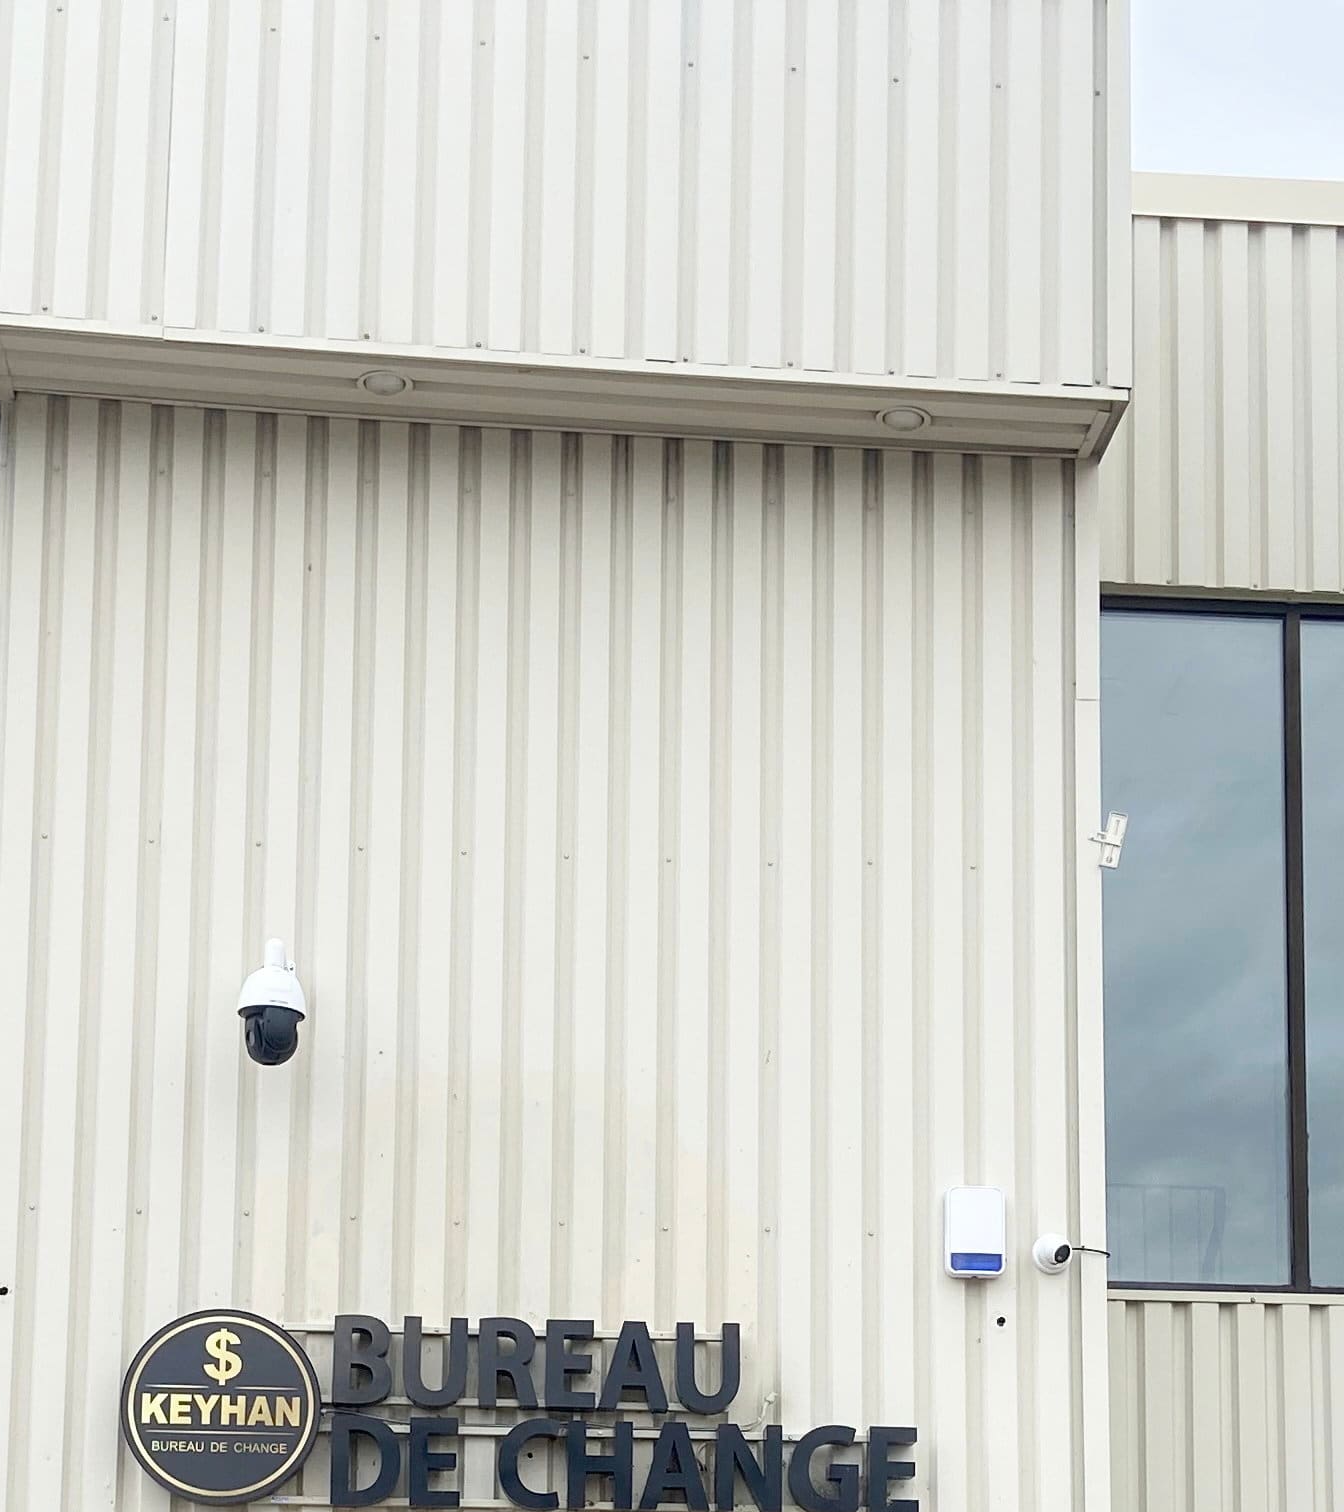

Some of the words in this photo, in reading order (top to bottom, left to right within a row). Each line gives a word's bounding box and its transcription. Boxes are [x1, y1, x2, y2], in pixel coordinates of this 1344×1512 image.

[332, 1315, 742, 1413] BUREAU
[141, 1392, 301, 1427] KEYHAN
[151, 1440, 205, 1453] BUREAU
[210, 1442, 228, 1453] DE
[233, 1442, 288, 1454] CHANGE
[329, 1412, 462, 1509] DE
